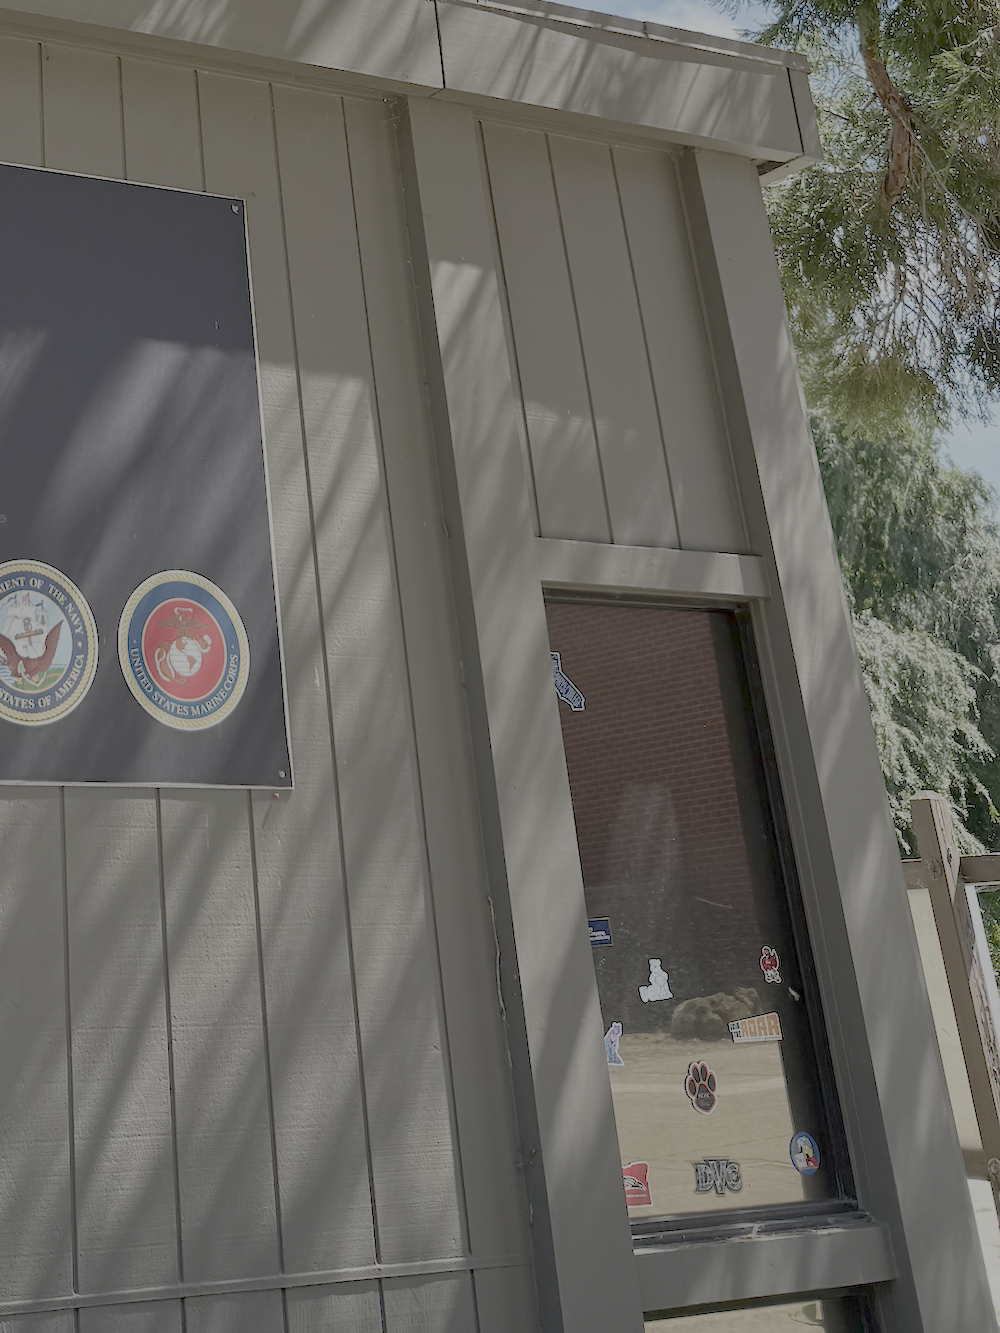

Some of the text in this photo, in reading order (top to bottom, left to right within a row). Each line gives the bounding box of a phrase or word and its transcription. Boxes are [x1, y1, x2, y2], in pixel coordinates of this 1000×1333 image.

[29, 577, 45, 589] OF
[47, 584, 68, 606] THE
[65, 602, 84, 635] NAVY
[38, 695, 52, 708] OF
[54, 654, 85, 702] AMERICA
[130, 648, 239, 716] UNITED STATES MARINE CORPS
[740, 1014, 780, 1038] ROAR
[694, 1158, 741, 1195] DVC
